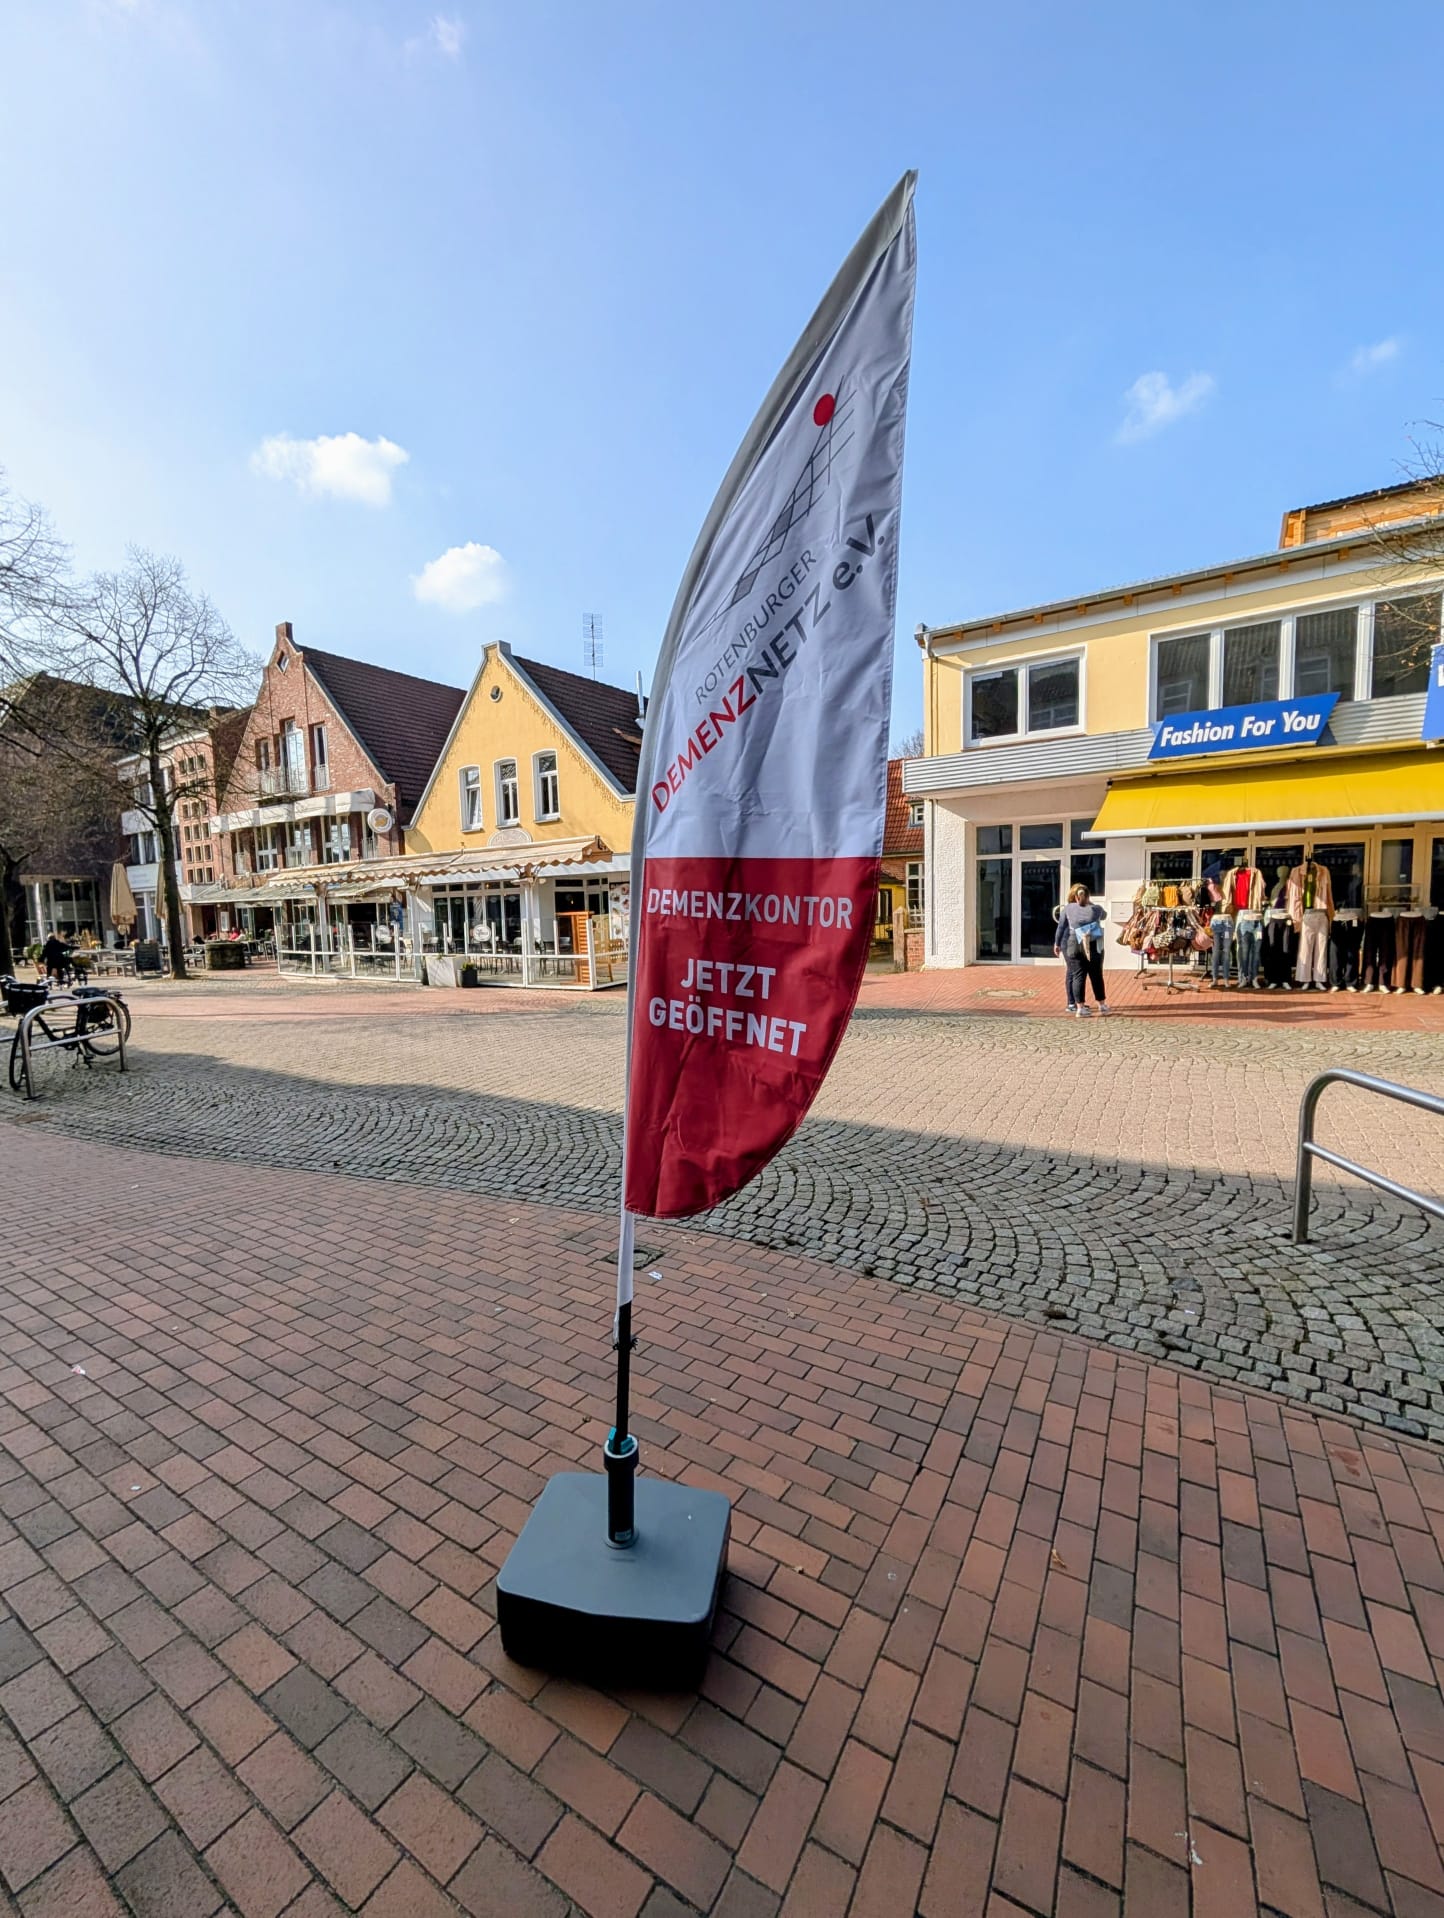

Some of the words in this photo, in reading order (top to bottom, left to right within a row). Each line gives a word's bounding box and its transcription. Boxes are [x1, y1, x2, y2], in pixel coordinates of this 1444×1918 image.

[695, 549, 816, 705] ROTENBURGER
[651, 582, 831, 813] DEMENZNETZ
[833, 512, 885, 590] e.V.
[1160, 721, 1234, 747] Fashion
[1241, 715, 1276, 737] For
[1282, 710, 1321, 733] You
[646, 888, 853, 929] DEMENZKONTOR
[680, 958, 776, 1000] JETZT
[648, 995, 807, 1056] GEÖFFNET
